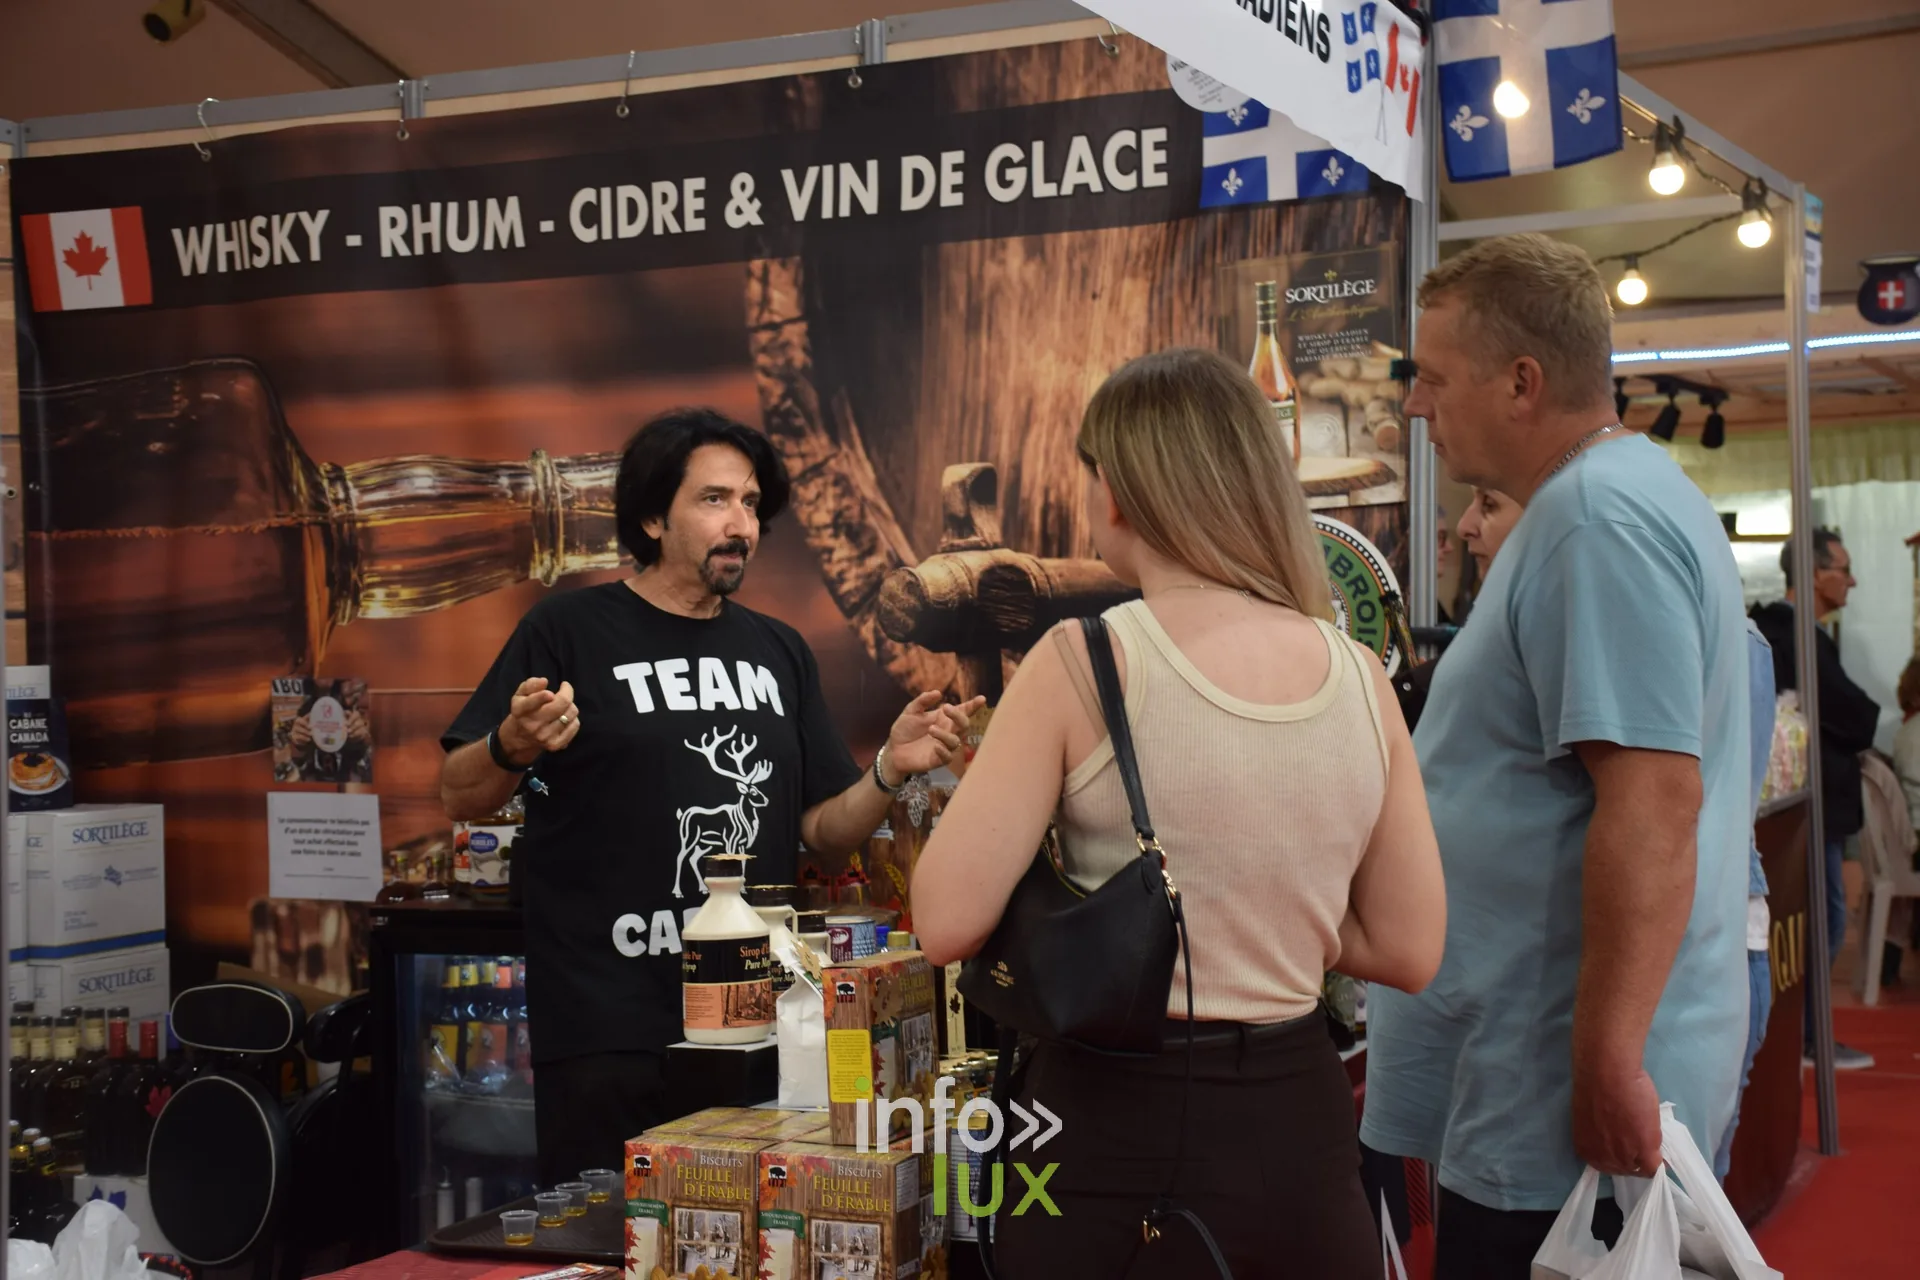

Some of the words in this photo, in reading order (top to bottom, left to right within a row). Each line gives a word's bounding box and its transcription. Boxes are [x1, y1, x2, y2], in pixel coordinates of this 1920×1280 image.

[171, 209, 330, 276] WHISKY
[378, 196, 526, 258] RHUM
[569, 177, 706, 243] CIDRE
[724, 172, 764, 229] &
[781, 160, 878, 223] VIN
[901, 150, 965, 212] DE
[984, 127, 1170, 203] GLACE
[1285, 279, 1377, 303] SORTILÈGE
[612, 657, 785, 717] TEAM
[9, 717, 47, 729] CABANE
[10, 732, 49, 744] CANADA
[72, 821, 148, 845] SORTILÈGE
[612, 907, 703, 958] CA
[740, 945, 761, 960] Sirop
[745, 959, 760, 970] Pure
[78, 967, 156, 995] SORTILÈGE
[700, 1154, 743, 1167] BISCUITS
[677, 1165, 732, 1183] FEUILLE
[838, 1165, 882, 1178] BISCUITS
[684, 1182, 750, 1200] D'ÉRABLE
[814, 1175, 871, 1194] FEUILLE
[821, 1192, 891, 1212] D'ÉRABLE
